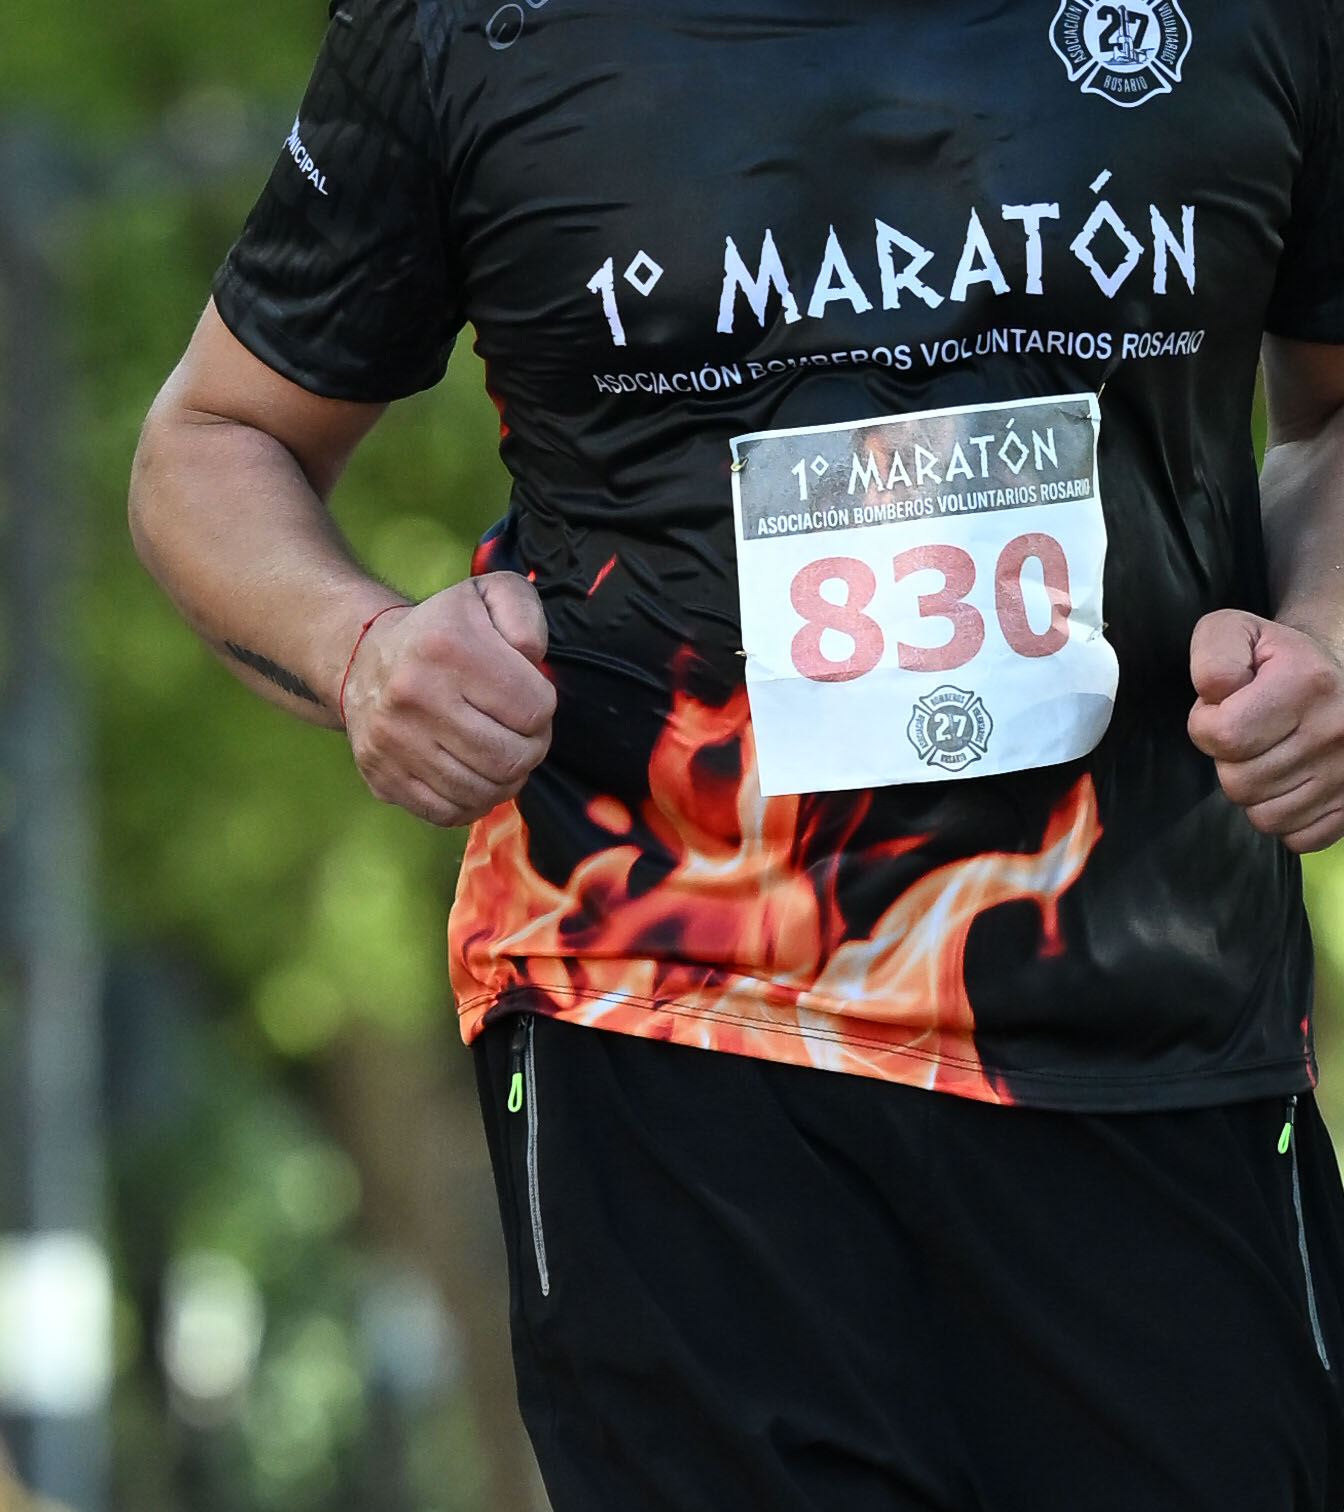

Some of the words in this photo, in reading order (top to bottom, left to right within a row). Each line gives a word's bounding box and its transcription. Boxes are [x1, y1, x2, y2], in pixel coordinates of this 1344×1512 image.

[1063, 5, 1087, 64] ASOCIACIÓN
[1097, 5, 1149, 52] 27
[1158, 2, 1179, 65] VOLUNTARIOS
[1104, 74, 1148, 93] ROSARIO
[716, 169, 1196, 334] MARATÓN
[592, 362, 742, 395] ASOCIACIÓN
[920, 328, 1113, 368] VOLUNTARIOS
[1122, 330, 1205, 360] ROSARIO
[848, 418, 1058, 495] MARATÓN
[757, 505, 849, 535] ASOCIACIÓN
[853, 496, 934, 524] BOMBEROS
[937, 485, 1037, 513] VOLUNTARIOS
[1040, 478, 1090, 501] ROSARIO
[790, 532, 1072, 682] 830
[934, 713, 967, 742] 27
